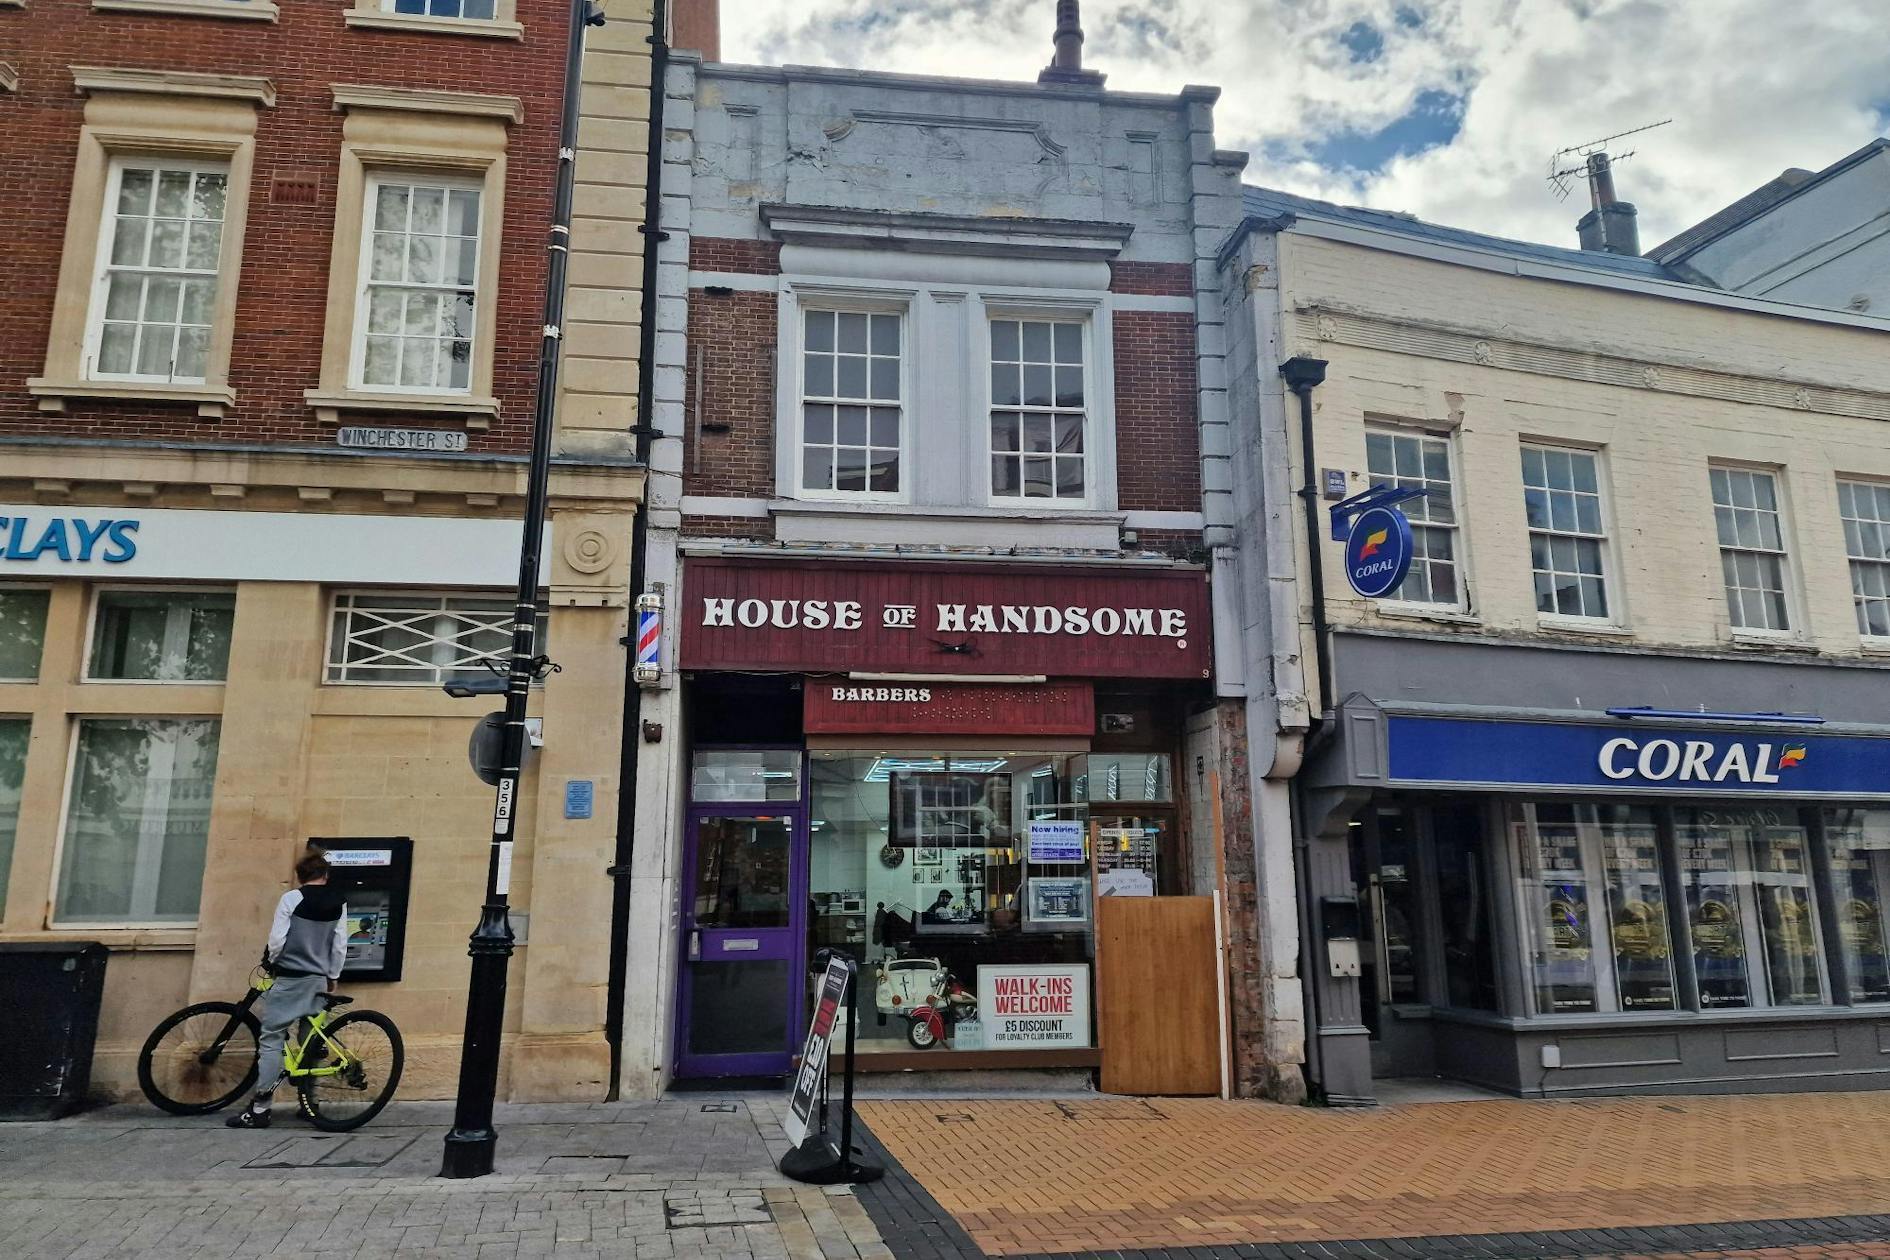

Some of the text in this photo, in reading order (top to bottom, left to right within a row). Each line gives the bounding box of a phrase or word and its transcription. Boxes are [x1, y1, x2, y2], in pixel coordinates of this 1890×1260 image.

[341, 428, 436, 449] WINCHESTER
[0, 516, 140, 564] LAYS
[1355, 558, 1394, 579] CORAL
[701, 597, 1188, 638] HOUSE OF HANDSOME
[1202, 668, 1210, 679] 9
[831, 687, 932, 702] BARBERS
[1598, 737, 1780, 784] CORAL
[1031, 825, 1080, 835] Now hiring
[994, 977, 1073, 996] WALK-INS
[994, 995, 1073, 1014] WELCOME
[1005, 1019, 1063, 1033] £5 DISCOUNT
[995, 1032, 1074, 1041] FOR LOYALTY CLUB MEMBERS
